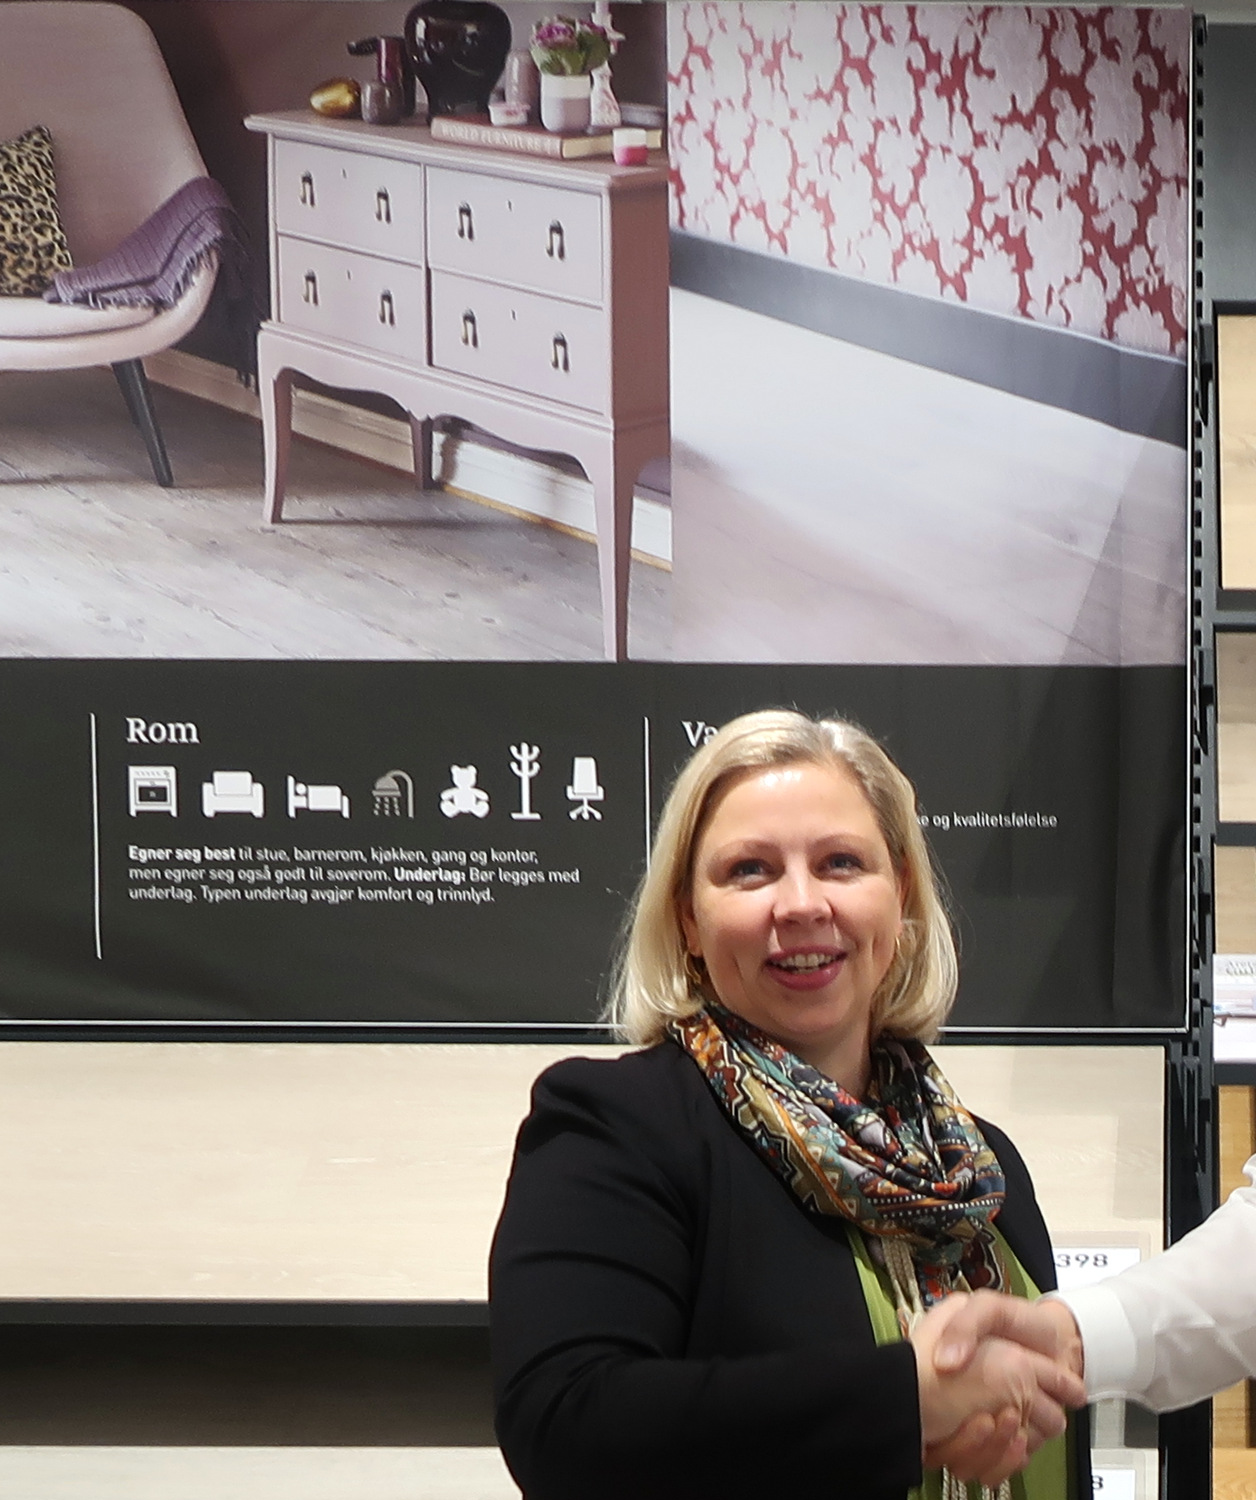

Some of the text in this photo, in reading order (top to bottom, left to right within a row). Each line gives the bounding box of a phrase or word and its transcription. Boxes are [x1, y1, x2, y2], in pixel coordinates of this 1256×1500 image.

[125, 717, 199, 744] Rom
[933, 814, 950, 831] og
[128, 845, 539, 866] Egner seg best til stue, barnerom, kjøkken, gang og kontor,
[129, 864, 580, 886] men egner seg også godt til soverom. Underlag: Bør legges med
[128, 885, 496, 905] underlag. Typen underlag avgjør komfort og trinnlyd.
[1055, 1253, 1109, 1268] 398
